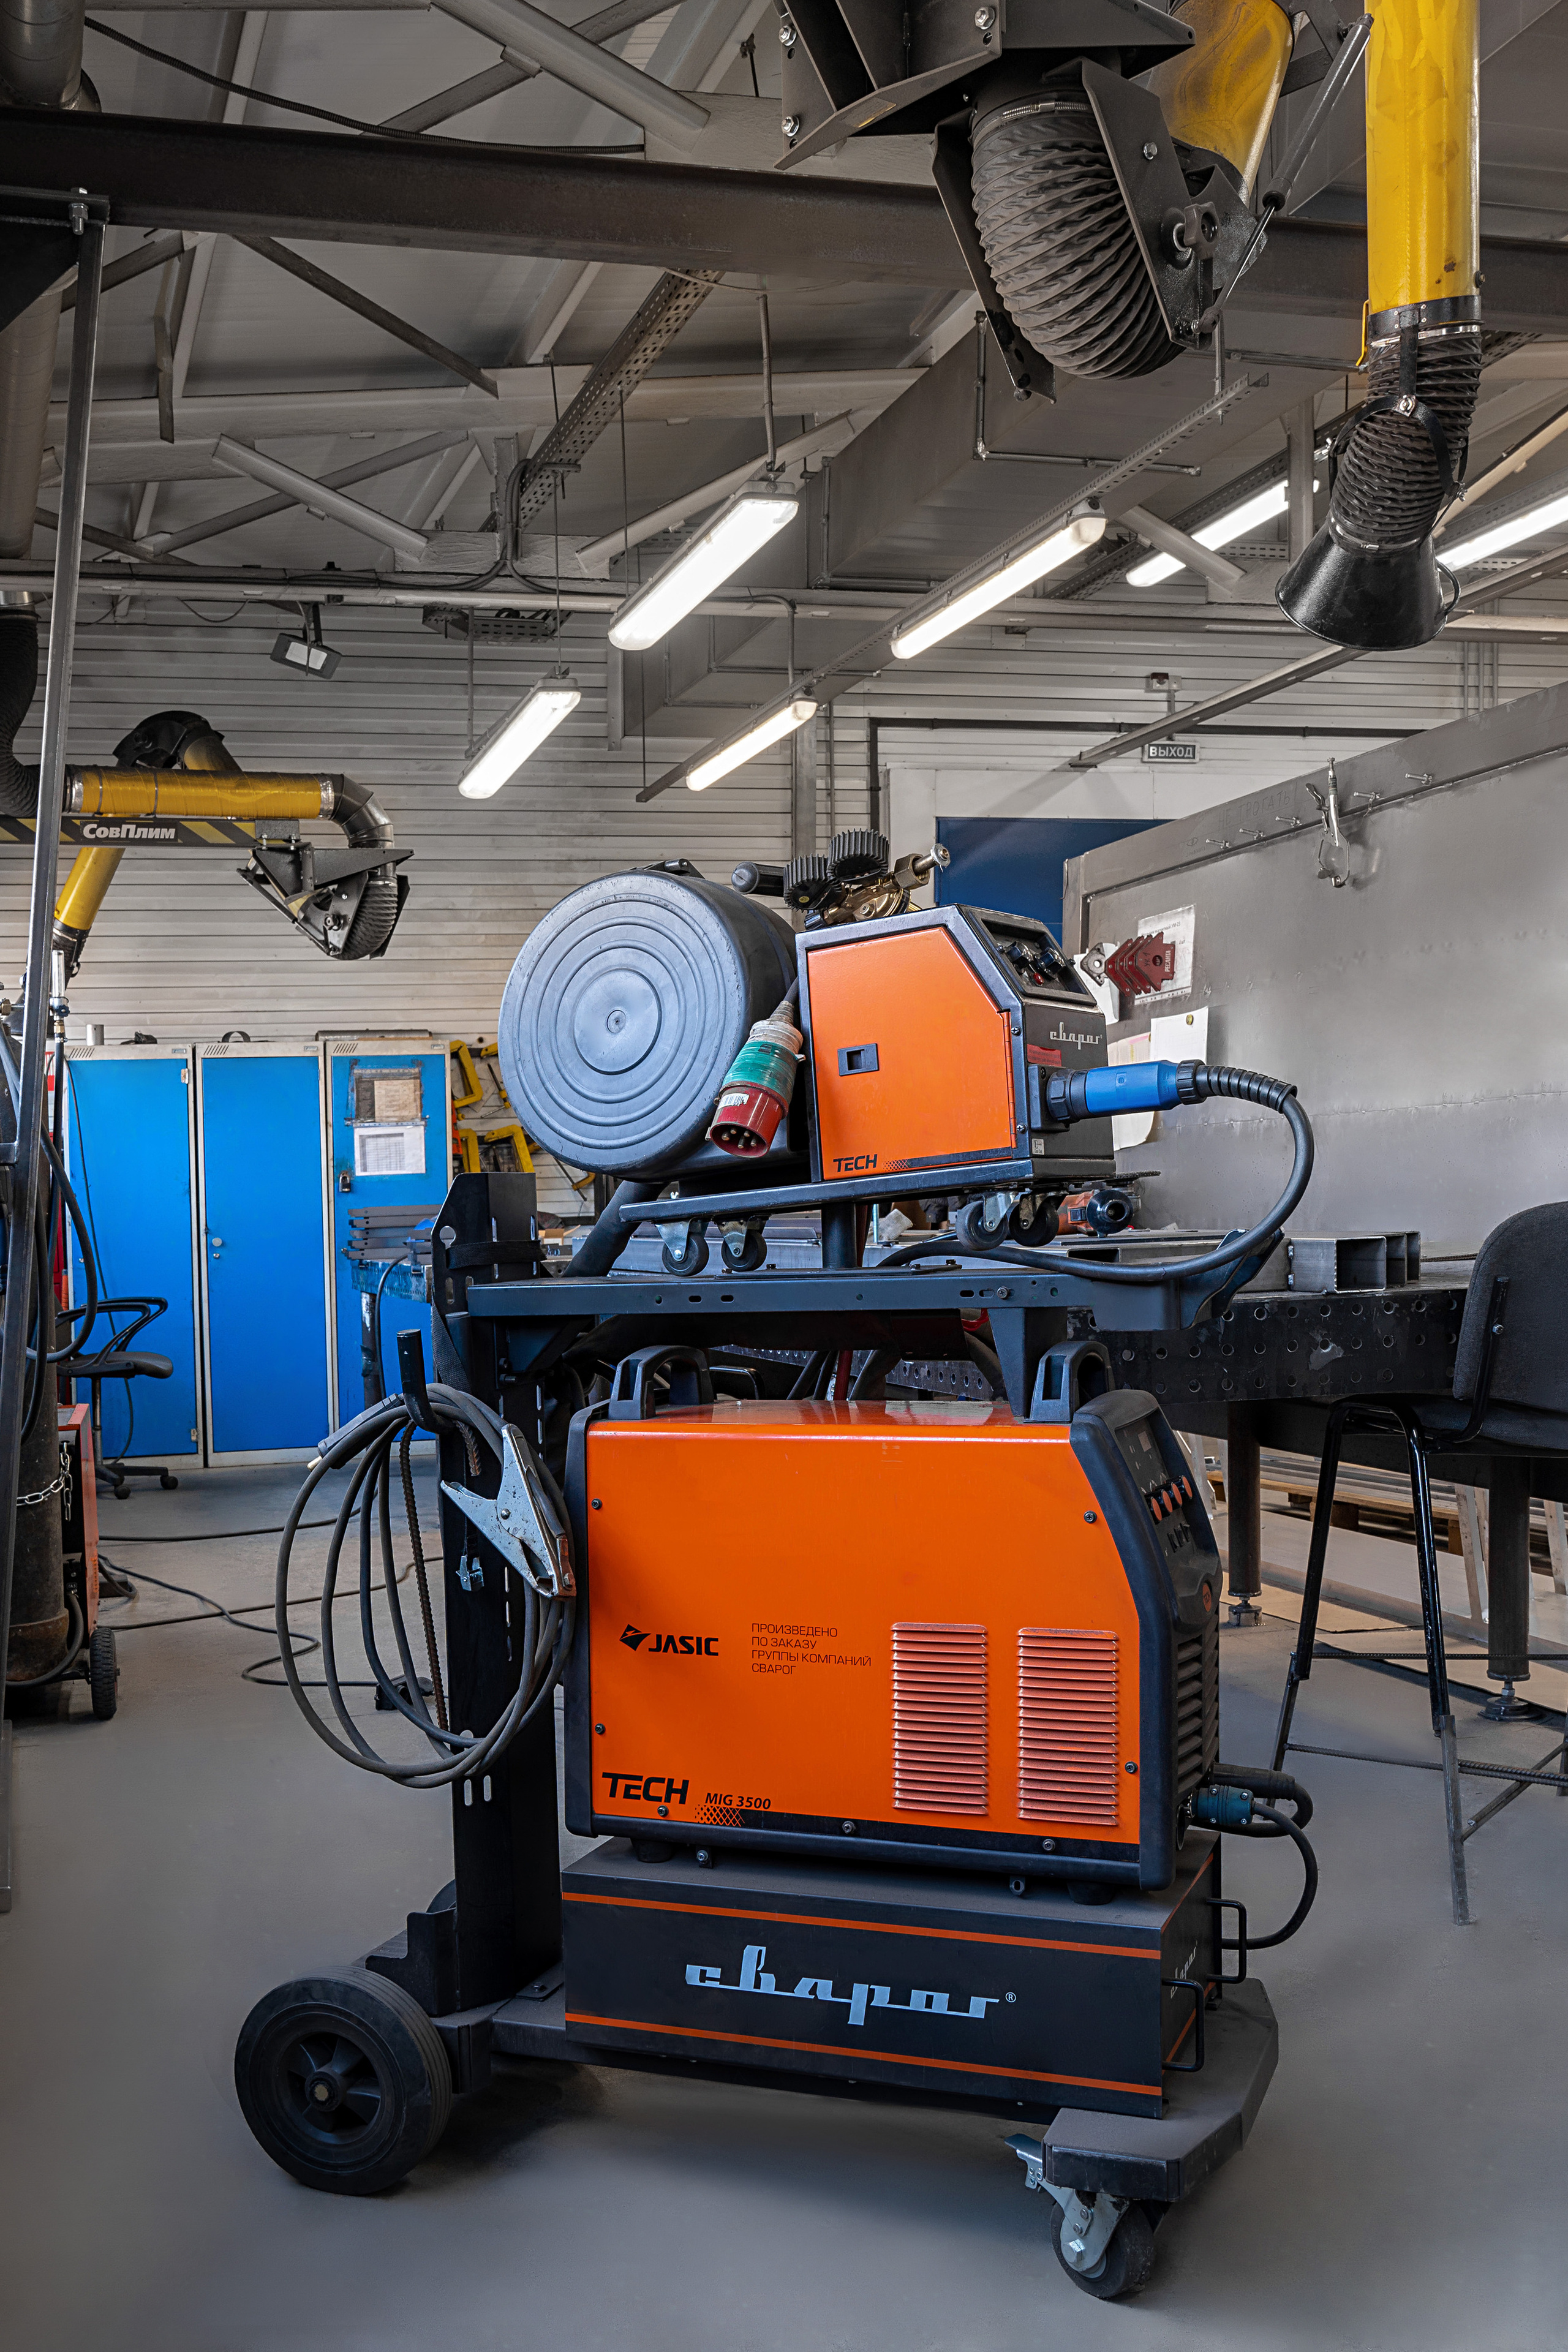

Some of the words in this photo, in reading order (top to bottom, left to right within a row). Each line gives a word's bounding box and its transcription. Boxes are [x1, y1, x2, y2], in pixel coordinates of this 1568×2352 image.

[1149, 746, 1193, 758] ВЫХОД
[1218, 808, 1231, 828] НЕ
[83, 823, 176, 839] СовПлим
[833, 1153, 878, 1172] TECH
[752, 1623, 838, 1637] ПРОИЗВЕДЕНО
[648, 1634, 719, 1656] JASIC
[752, 1637, 768, 1646] ПО
[771, 1637, 817, 1649] ЗАКАЗУ
[752, 1649, 799, 1662] ГРУППЫ
[801, 1653, 872, 1667] КОМПАНИЙ
[752, 1663, 796, 1675] СВАРОГ
[601, 1771, 690, 1804] TECH
[704, 1792, 734, 1806] MIG
[736, 1795, 771, 1809] 3500
